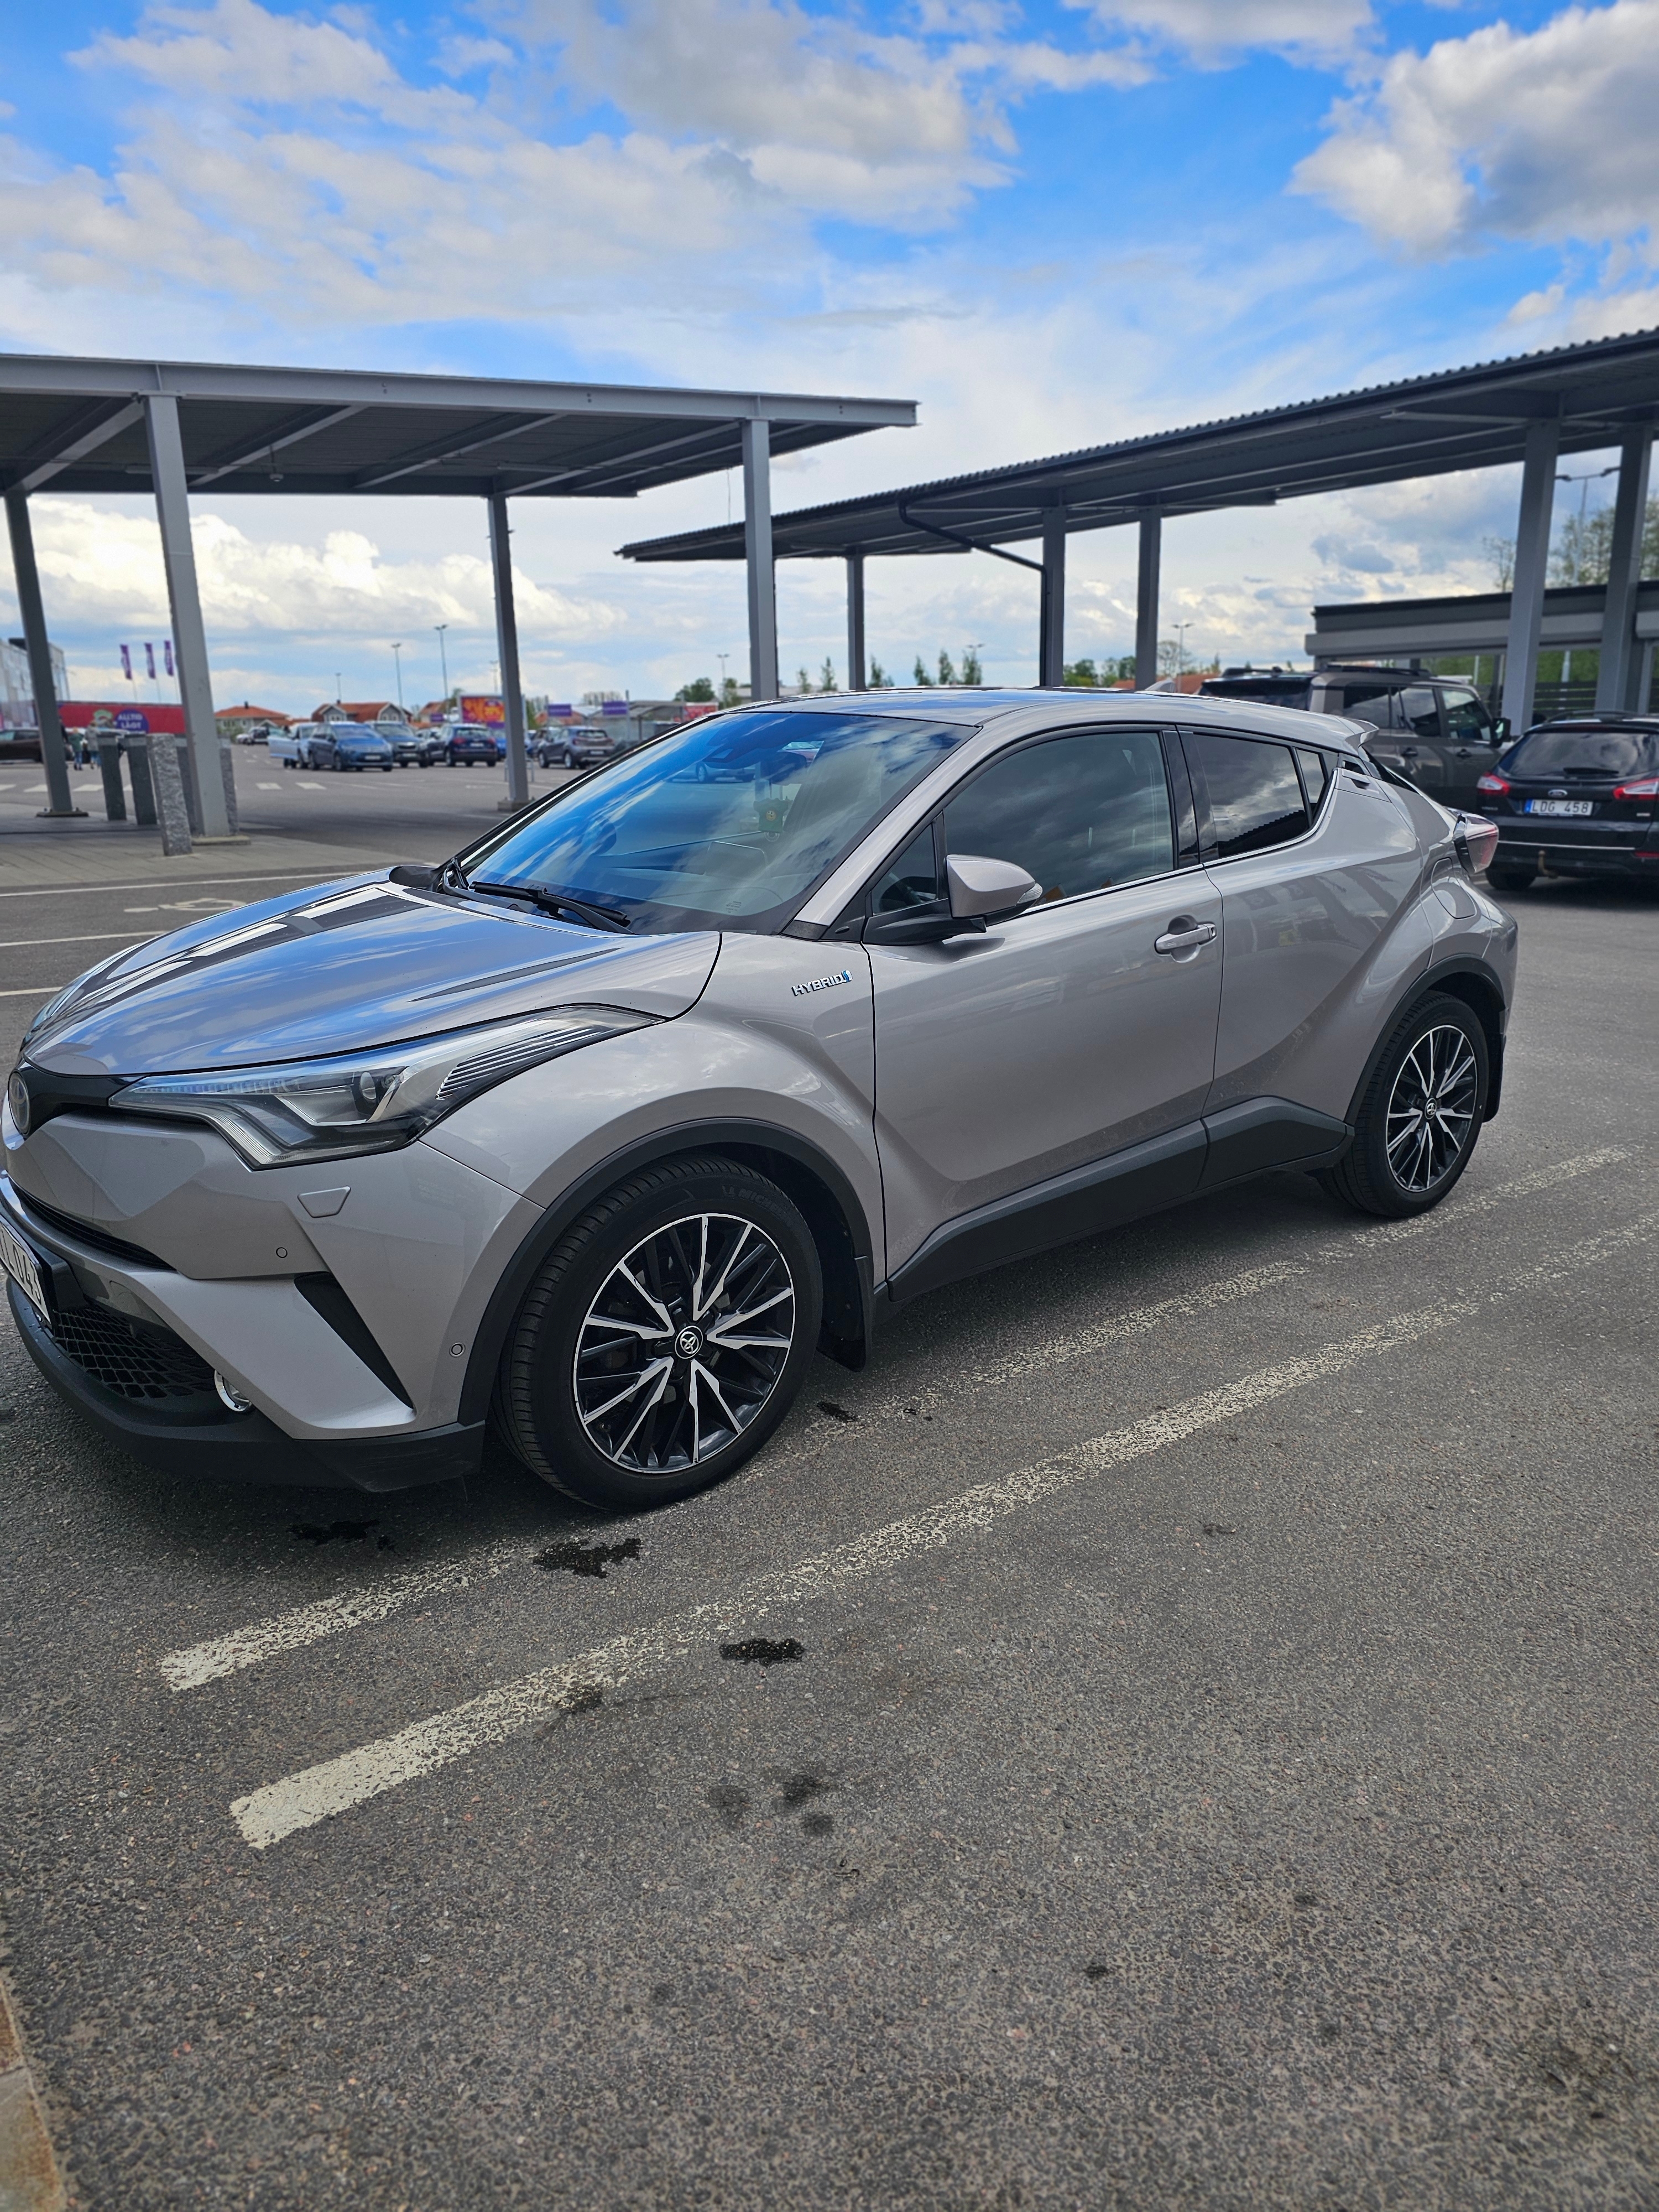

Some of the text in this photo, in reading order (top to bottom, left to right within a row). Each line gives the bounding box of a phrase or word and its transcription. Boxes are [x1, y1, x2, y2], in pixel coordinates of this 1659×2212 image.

[1532, 800, 1589, 813] LDG 458
[791, 974, 847, 996] HYBRID
